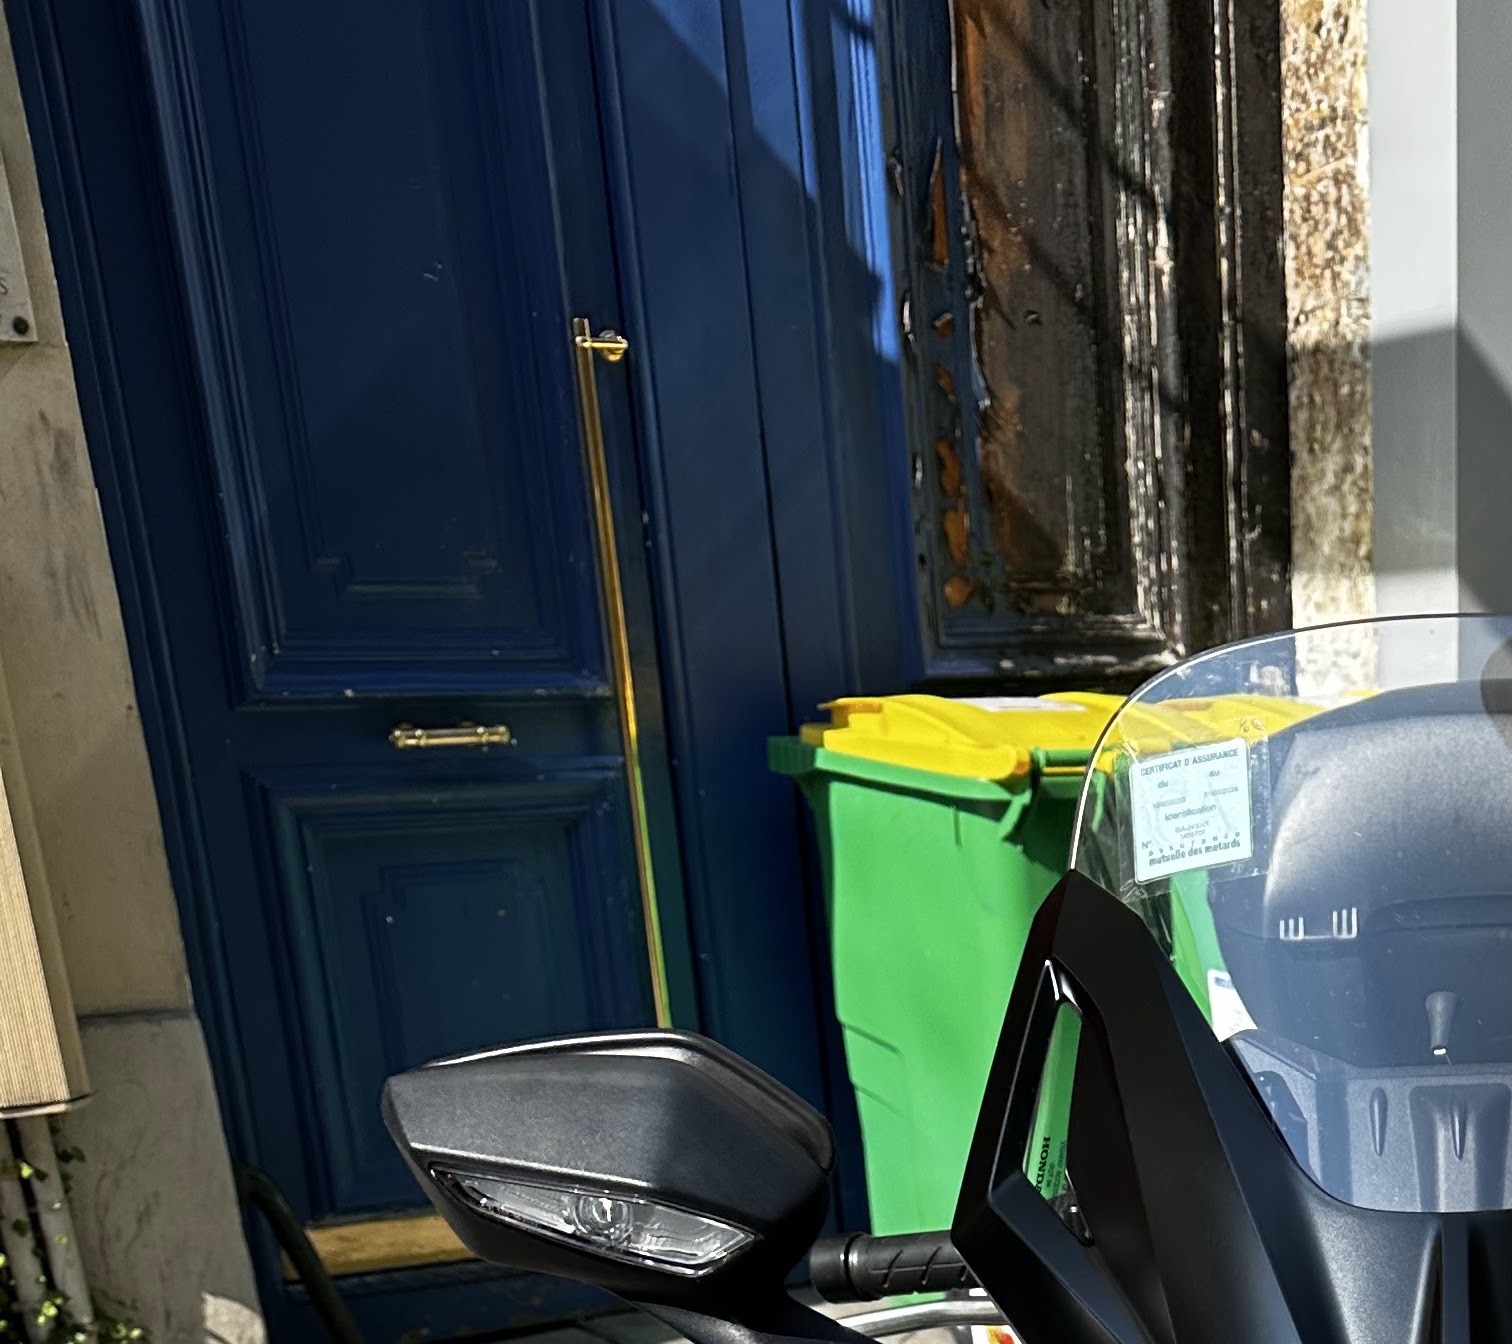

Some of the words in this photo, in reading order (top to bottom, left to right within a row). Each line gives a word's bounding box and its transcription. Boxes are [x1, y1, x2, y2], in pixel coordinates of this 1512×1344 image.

[1140, 760, 1182, 777] CERTIFICAT
[1208, 770, 1220, 778] au
[1158, 779, 1169, 788] du
[1149, 848, 1186, 866] mutuelle
[1187, 845, 1203, 857] des
[1205, 838, 1241, 852] motards
